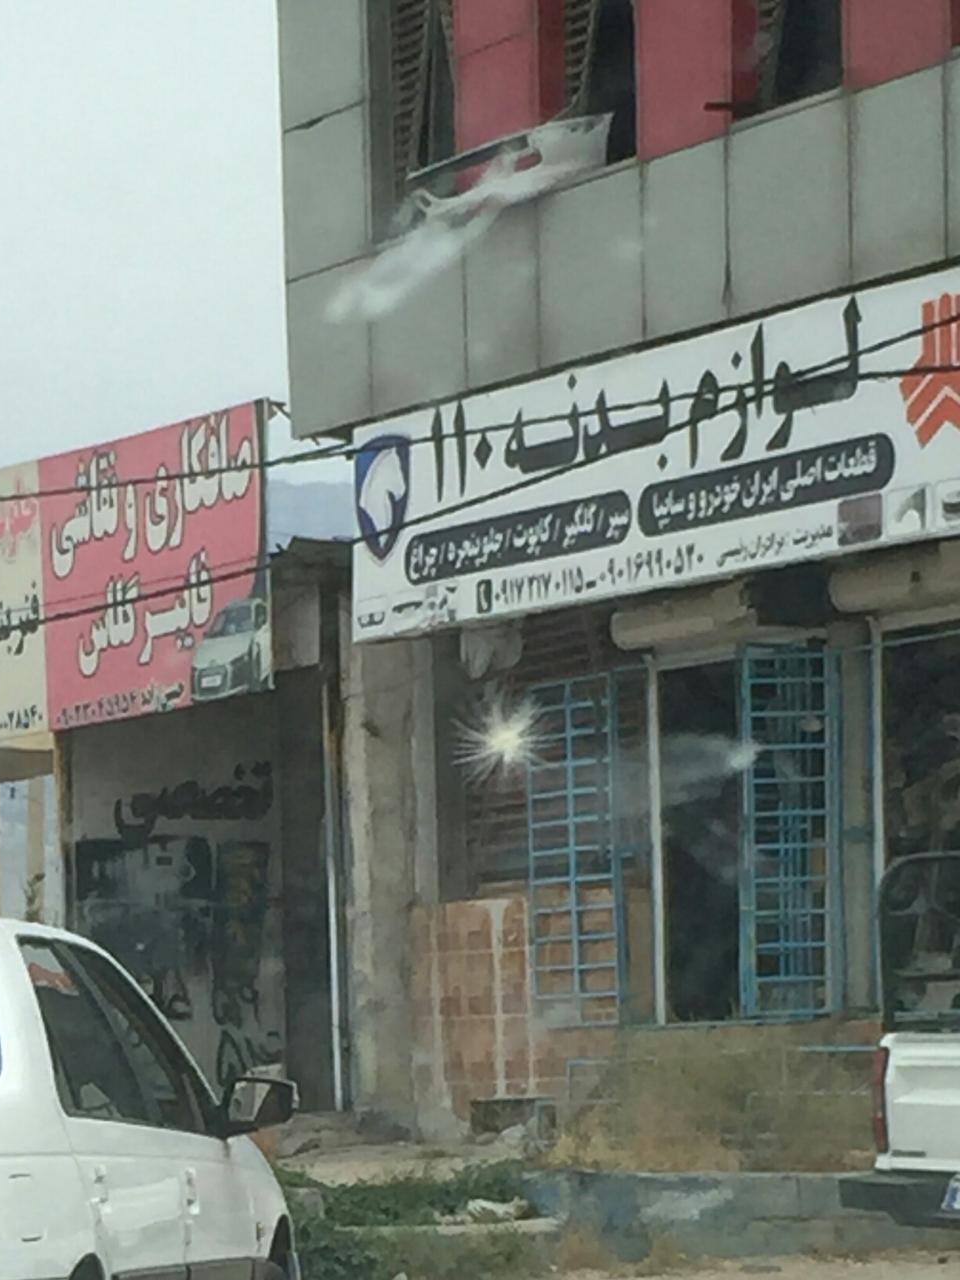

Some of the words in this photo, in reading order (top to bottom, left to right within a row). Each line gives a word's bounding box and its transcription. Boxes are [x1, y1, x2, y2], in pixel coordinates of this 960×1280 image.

[689, 295, 862, 469] لوازم
[504, 373, 670, 474] بدنه
[431, 400, 493, 503] ۱۱۰
[824, 441, 878, 481] قطعات
[145, 414, 252, 553] صافکاری
[698, 475, 741, 518] خودرو
[742, 467, 780, 508] ایران
[780, 457, 823, 500] اصلی
[50, 450, 118, 580] نقاشی
[122, 483, 138, 562] و
[563, 502, 597, 548] گلگیر
[606, 509, 630, 539] سپر
[652, 489, 685, 529] سایپا
[513, 513, 553, 555] کاپوت
[410, 538, 438, 580] چراغ
[78, 573, 140, 679] گلاس
[139, 549, 212, 665] فایبر
